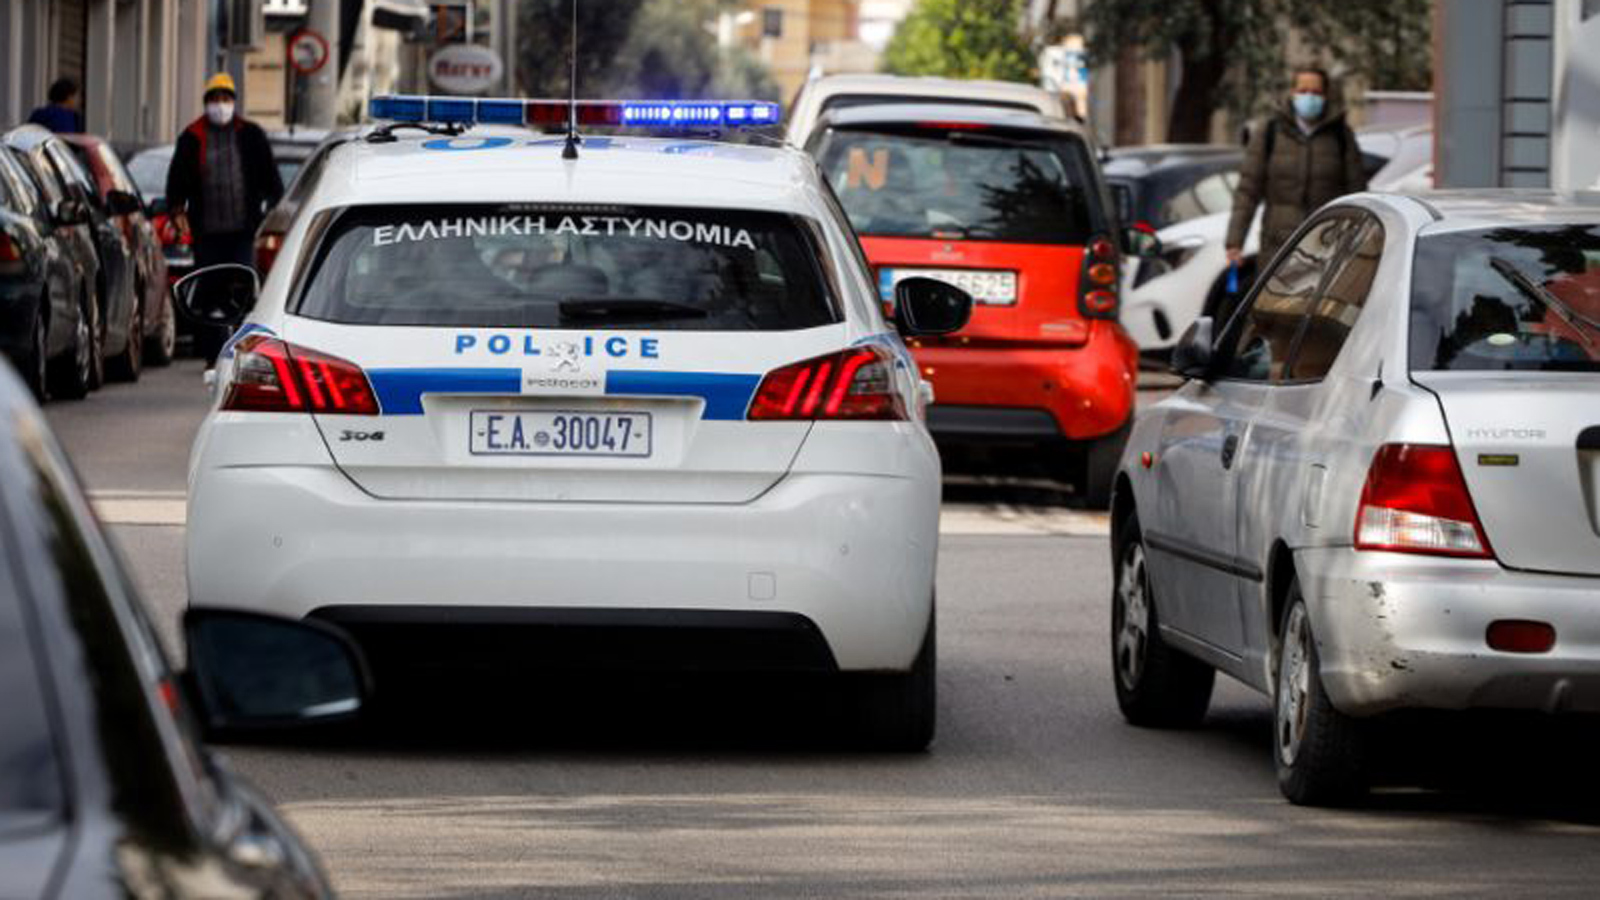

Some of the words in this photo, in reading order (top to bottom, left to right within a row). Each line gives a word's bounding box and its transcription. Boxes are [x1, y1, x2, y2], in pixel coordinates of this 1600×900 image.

[847, 147, 887, 190] N
[373, 216, 545, 246] ΕΛΛΗΝΙΚΗ
[554, 216, 756, 250] ΑΣΤΥΝΟΜΙΑ
[455, 335, 660, 359] POLICE
[553, 415, 632, 451] 30047
[1467, 428, 1547, 439] HYUNDAI
